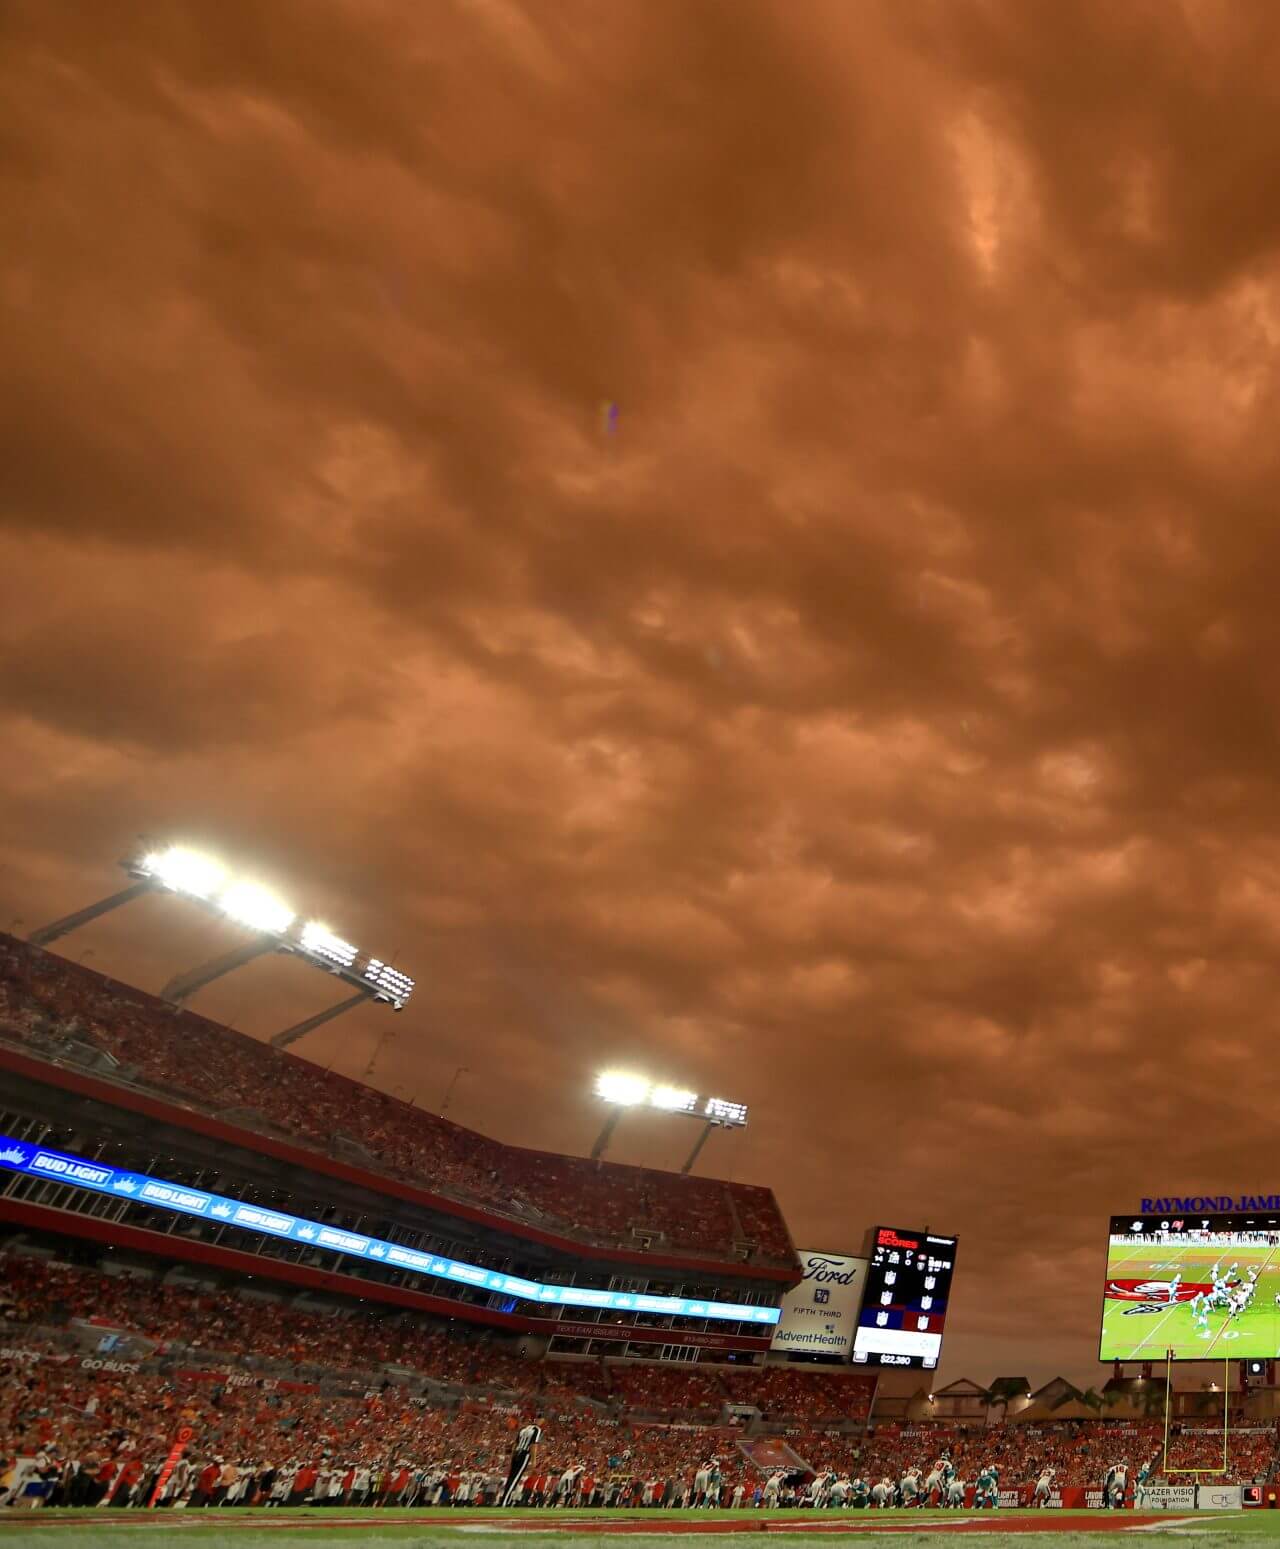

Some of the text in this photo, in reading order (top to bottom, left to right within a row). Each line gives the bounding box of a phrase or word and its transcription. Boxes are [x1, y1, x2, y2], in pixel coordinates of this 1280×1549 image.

[36, 1155, 109, 1183] BUD LIGHT
[144, 1185, 207, 1209] BUD LIGHT
[1141, 1195, 1232, 1213] RAYMOND
[1161, 1220, 1169, 1229] 0
[1202, 1220, 1209, 1228] 7
[878, 1237, 918, 1249] SCORES
[802, 1257, 857, 1285] Ford
[793, 1307, 842, 1318] FIFTH THIRD
[776, 1330, 847, 1346] AdventHealth
[81, 1359, 141, 1374] GO BUCS
[1173, 1488, 1193, 1496] VISIO
[1251, 1488, 1259, 1500] 9
